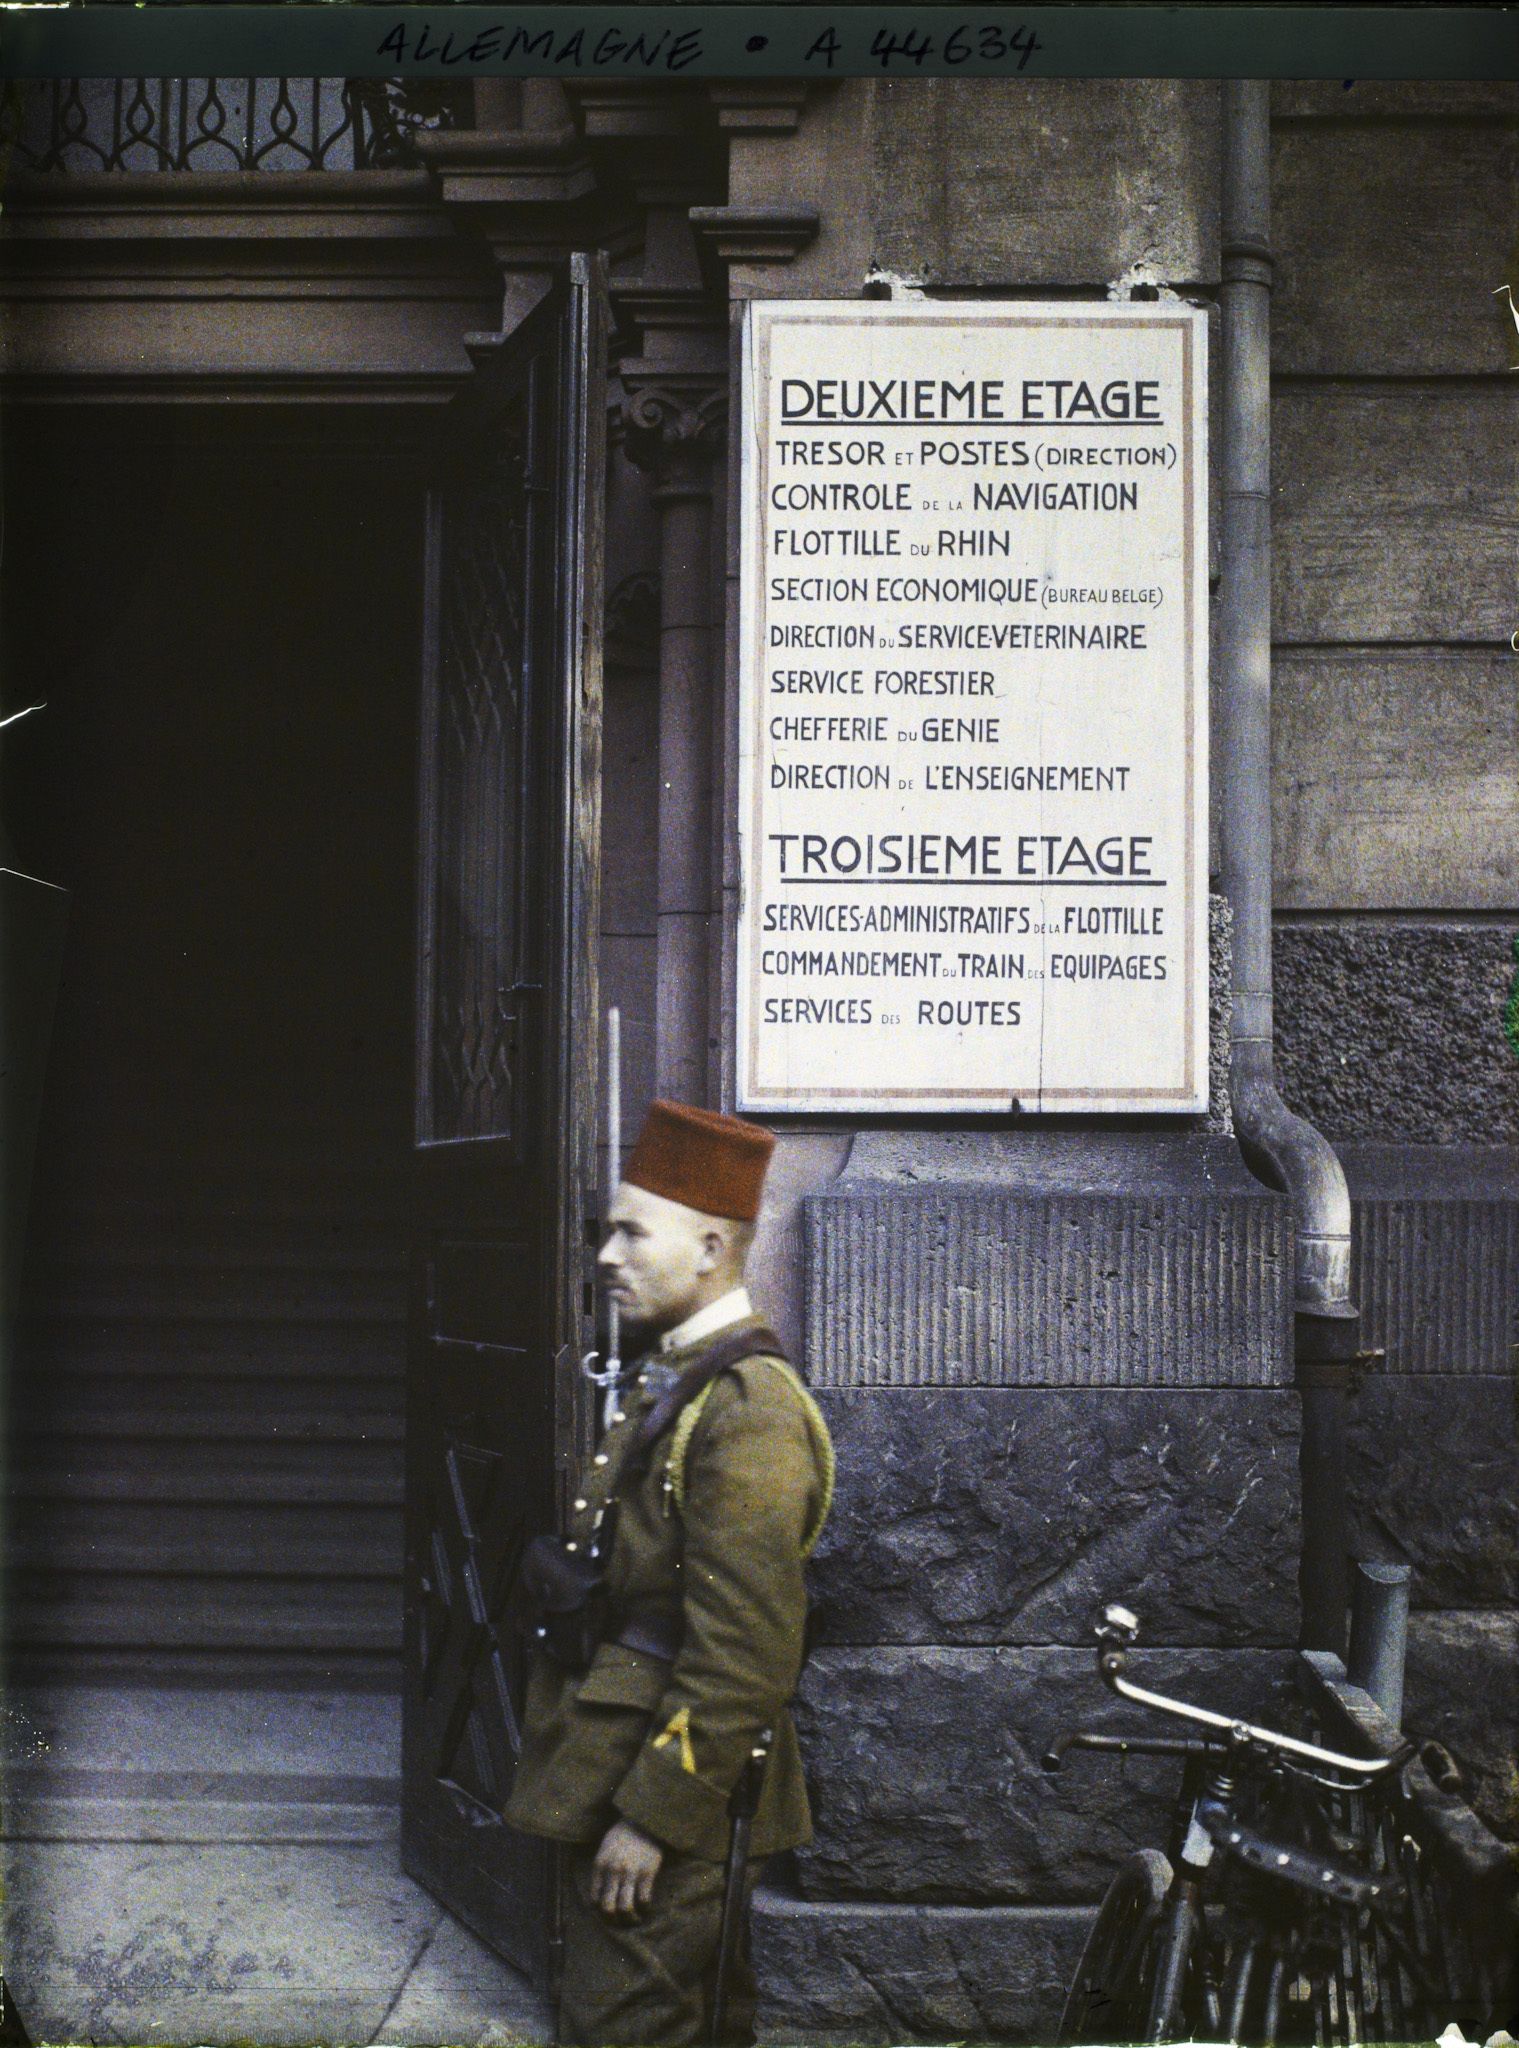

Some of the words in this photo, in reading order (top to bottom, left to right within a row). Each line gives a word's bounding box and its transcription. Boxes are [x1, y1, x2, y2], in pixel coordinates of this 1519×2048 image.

[781, 380, 1004, 419] DEUXIEME
[1022, 380, 1160, 419] ETAGE
[776, 440, 886, 465] TRESOR
[896, 452, 914, 465] ET
[921, 441, 1029, 465] POSTES
[1035, 442, 1177, 471] (DIRECTION)
[771, 483, 912, 511] CONTROLE
[922, 500, 939, 510] DE
[948, 500, 963, 510] LA
[973, 482, 1137, 510] NAVIGATION
[774, 530, 900, 556] FLOTTILLE
[911, 543, 930, 556] DU
[938, 530, 1010, 556] RHIN
[771, 578, 867, 601] SECTION
[877, 578, 1038, 606] ECONOMIQUE
[771, 624, 874, 648] DIRECTION
[879, 638, 894, 648] DU
[771, 670, 864, 694] SERVICE
[875, 670, 995, 696] FORESTIER
[769, 717, 888, 741] CHEFFERIE
[898, 731, 917, 742] DU
[922, 718, 999, 743] GENIE
[771, 765, 890, 789] DIRECTION
[899, 780, 913, 790] DE
[926, 766, 1131, 791] L'ENSEIGNEMENT
[768, 834, 1001, 874] TROISIEME
[1017, 836, 1152, 876] ETAGE
[1034, 924, 1046, 934] DE
[1048, 924, 1060, 934] LA
[1064, 906, 1164, 935] FLOTTILLE
[762, 951, 942, 977] COMMANDEMENT
[942, 968, 957, 978] DU
[958, 953, 1024, 978] TRAIN
[1027, 969, 1044, 979] DES
[1051, 954, 1167, 983] EQUIPAGES
[764, 999, 872, 1024] SERVICES
[881, 1014, 900, 1025] DES
[918, 1001, 1020, 1026] ROUTES
